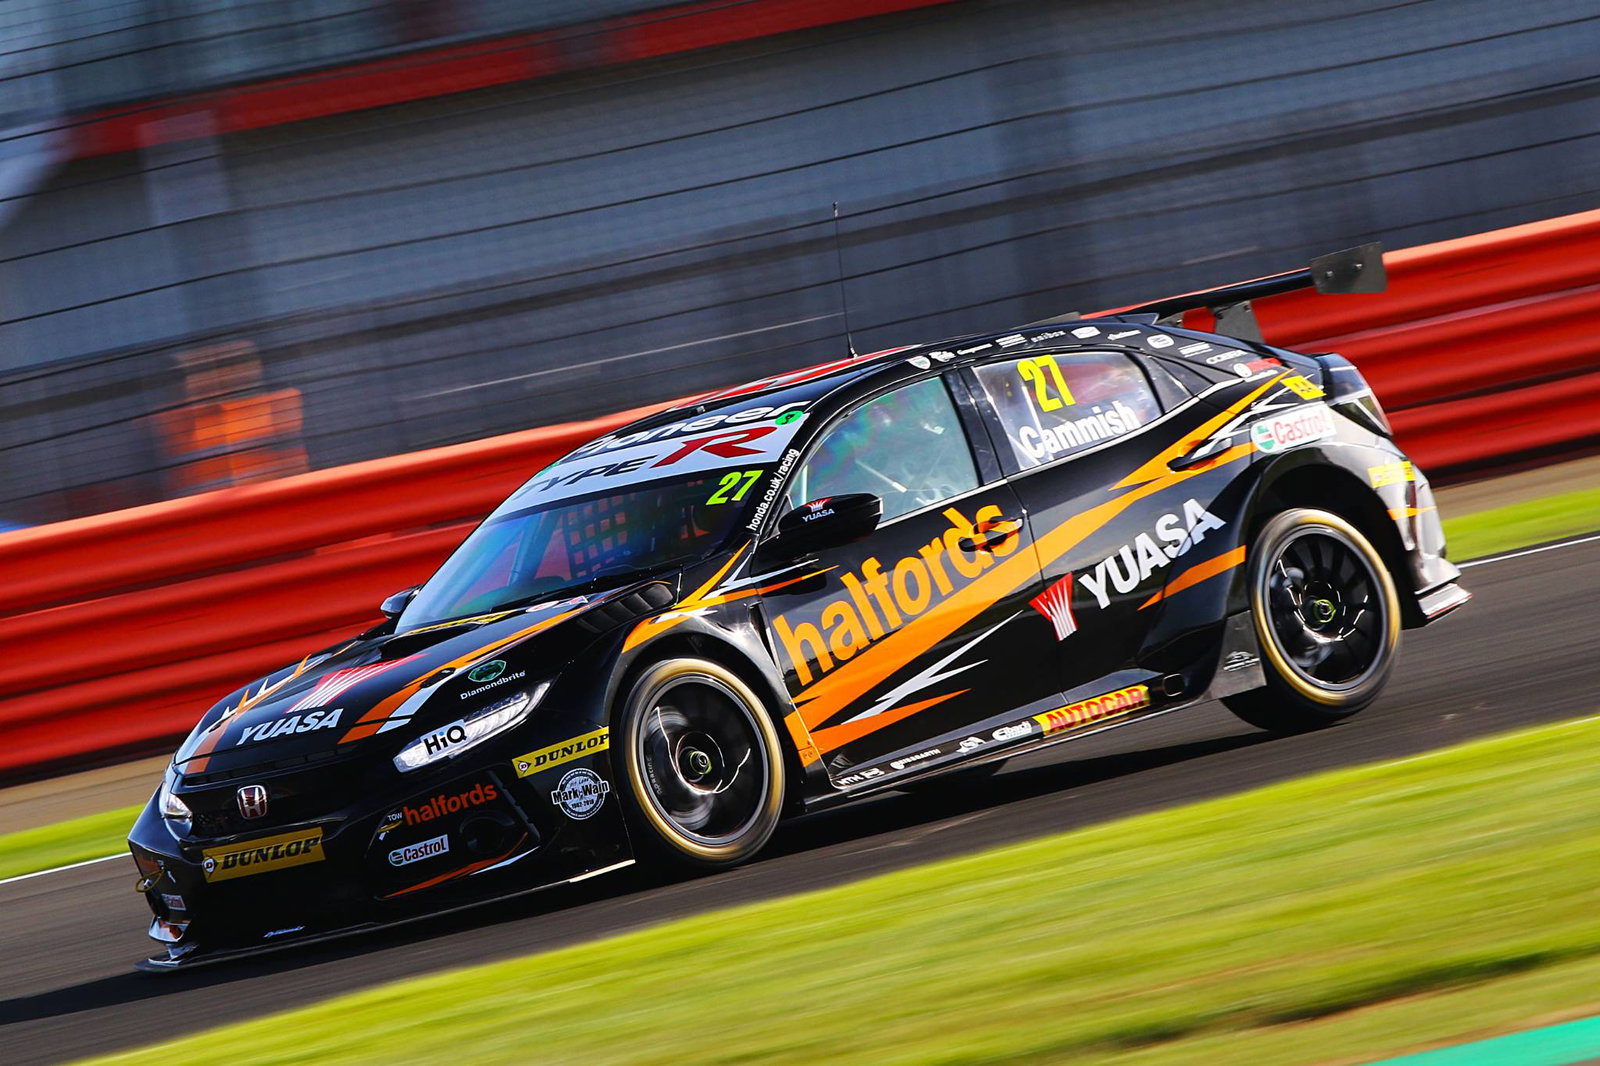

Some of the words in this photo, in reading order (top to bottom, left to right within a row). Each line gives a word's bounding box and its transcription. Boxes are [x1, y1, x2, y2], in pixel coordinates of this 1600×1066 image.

[1017, 354, 1076, 413] 27
[1018, 401, 1142, 460] Cammish
[1273, 408, 1332, 445] Castrol
[648, 427, 777, 468] R
[706, 470, 763, 505] 27
[746, 448, 800, 531] honda.co.uk/racing
[802, 508, 835, 522] YUASA
[1078, 498, 1227, 610] YUASA
[771, 504, 1021, 686] halfords
[460, 671, 525, 700] Diamondbrite
[236, 707, 344, 747] YUASA
[1045, 687, 1145, 733] AUTOCAR
[423, 725, 467, 755] HiQ
[534, 733, 609, 767] DUNLOP
[403, 784, 497, 825] halfords
[552, 787, 579, 803] Mark
[582, 782, 608, 796] Wain
[387, 812, 403, 822] TOW
[221, 837, 320, 871] DUNLOP
[403, 838, 447, 862] Castrol
